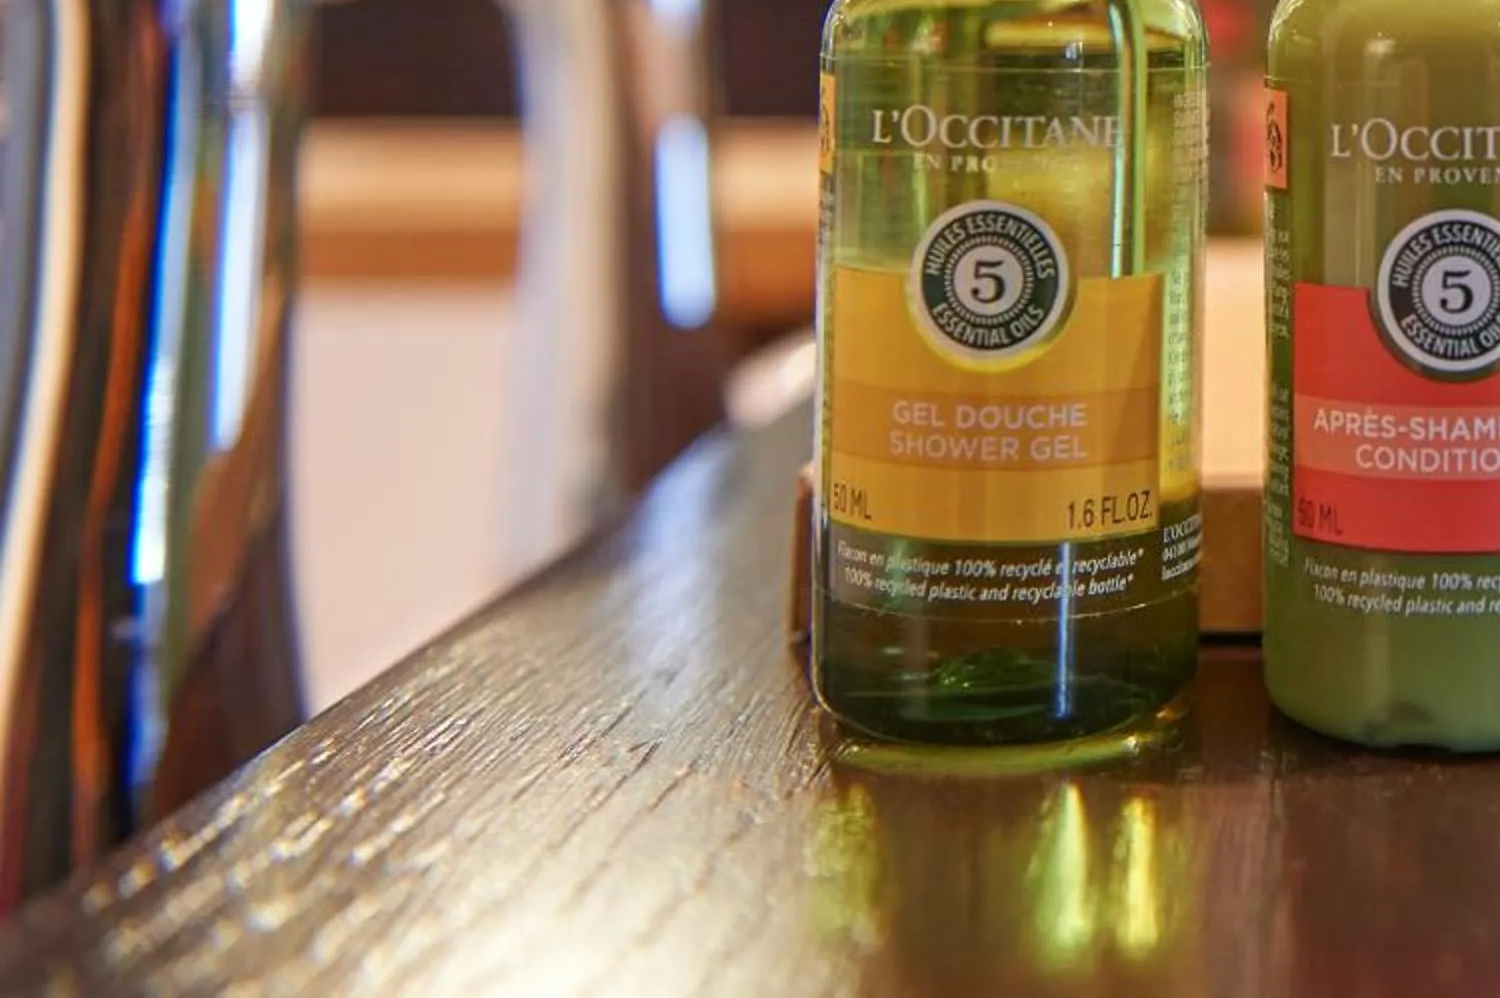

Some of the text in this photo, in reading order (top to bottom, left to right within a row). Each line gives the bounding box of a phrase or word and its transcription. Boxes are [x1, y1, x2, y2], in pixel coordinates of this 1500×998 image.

[872, 104, 1122, 149] L'OCCITANE
[913, 153, 942, 171] EN
[1375, 165, 1403, 183] EN
[925, 213, 1056, 279] HUILES ESSENTIELLES
[1391, 232, 1433, 287] HUILES
[970, 260, 1005, 303] 5
[1439, 269, 1474, 314] 5
[932, 303, 1044, 347] ESSENTIAL OILS
[1400, 313, 1480, 358] ESSENTIAL
[892, 400, 1088, 429] GEL DOUCHE
[889, 431, 1087, 461] SHOWER GEL
[833, 482, 872, 520] 50 ML
[1068, 499, 1095, 530] 1.6
[1319, 503, 1343, 535] ML
[870, 554, 885, 566] en
[954, 559, 997, 578] 100%
[1341, 568, 1357, 583] en
[1360, 568, 1425, 592] plastique
[1433, 572, 1473, 591] 100%
[844, 567, 872, 588] 100%
[876, 578, 927, 598] recycled
[928, 581, 976, 602] plastic
[979, 583, 1009, 601] and
[1314, 583, 1345, 604] 100%
[1347, 592, 1404, 613] recycled
[1405, 594, 1452, 617] plastic
[1456, 597, 1487, 615] and
